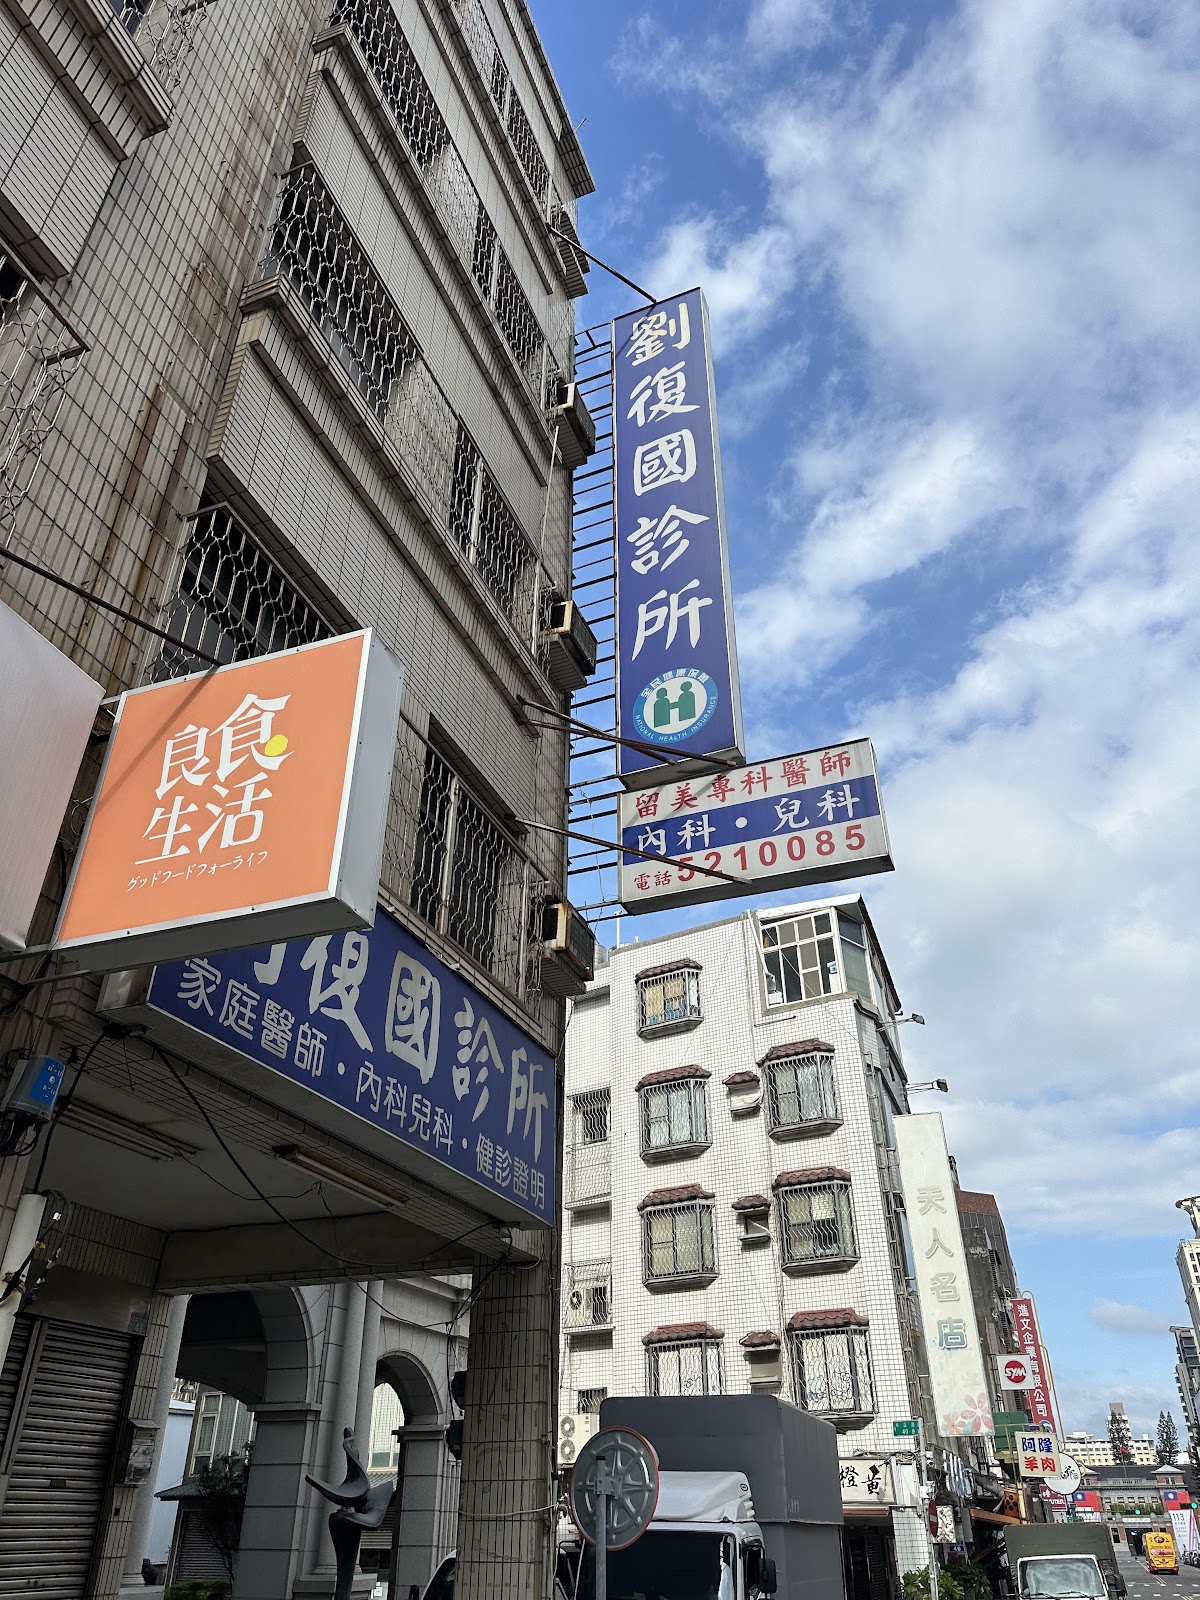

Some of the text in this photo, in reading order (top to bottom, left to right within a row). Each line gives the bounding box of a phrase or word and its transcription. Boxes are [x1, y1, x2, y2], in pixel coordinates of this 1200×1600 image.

[625, 302, 714, 661] 劉復國診所
[155, 693, 294, 800] 良食
[635, 695, 717, 742] NATIONAL HEALTH INSURANCE
[635, 750, 851, 819] 留美專科醫師
[135, 772, 273, 866] 生活
[126, 850, 269, 892] グッドフードフォーライフ
[633, 823, 866, 891] 電話 5210085
[253, 931, 549, 1162] 復國診所
[916, 1187, 967, 1350] 天人名店
[1005, 1366, 1027, 1379] SYM
[1021, 1437, 1053, 1453] 阿隆
[1024, 1456, 1056, 1473] 羊肉
[1172, 1513, 1185, 1521] 113
